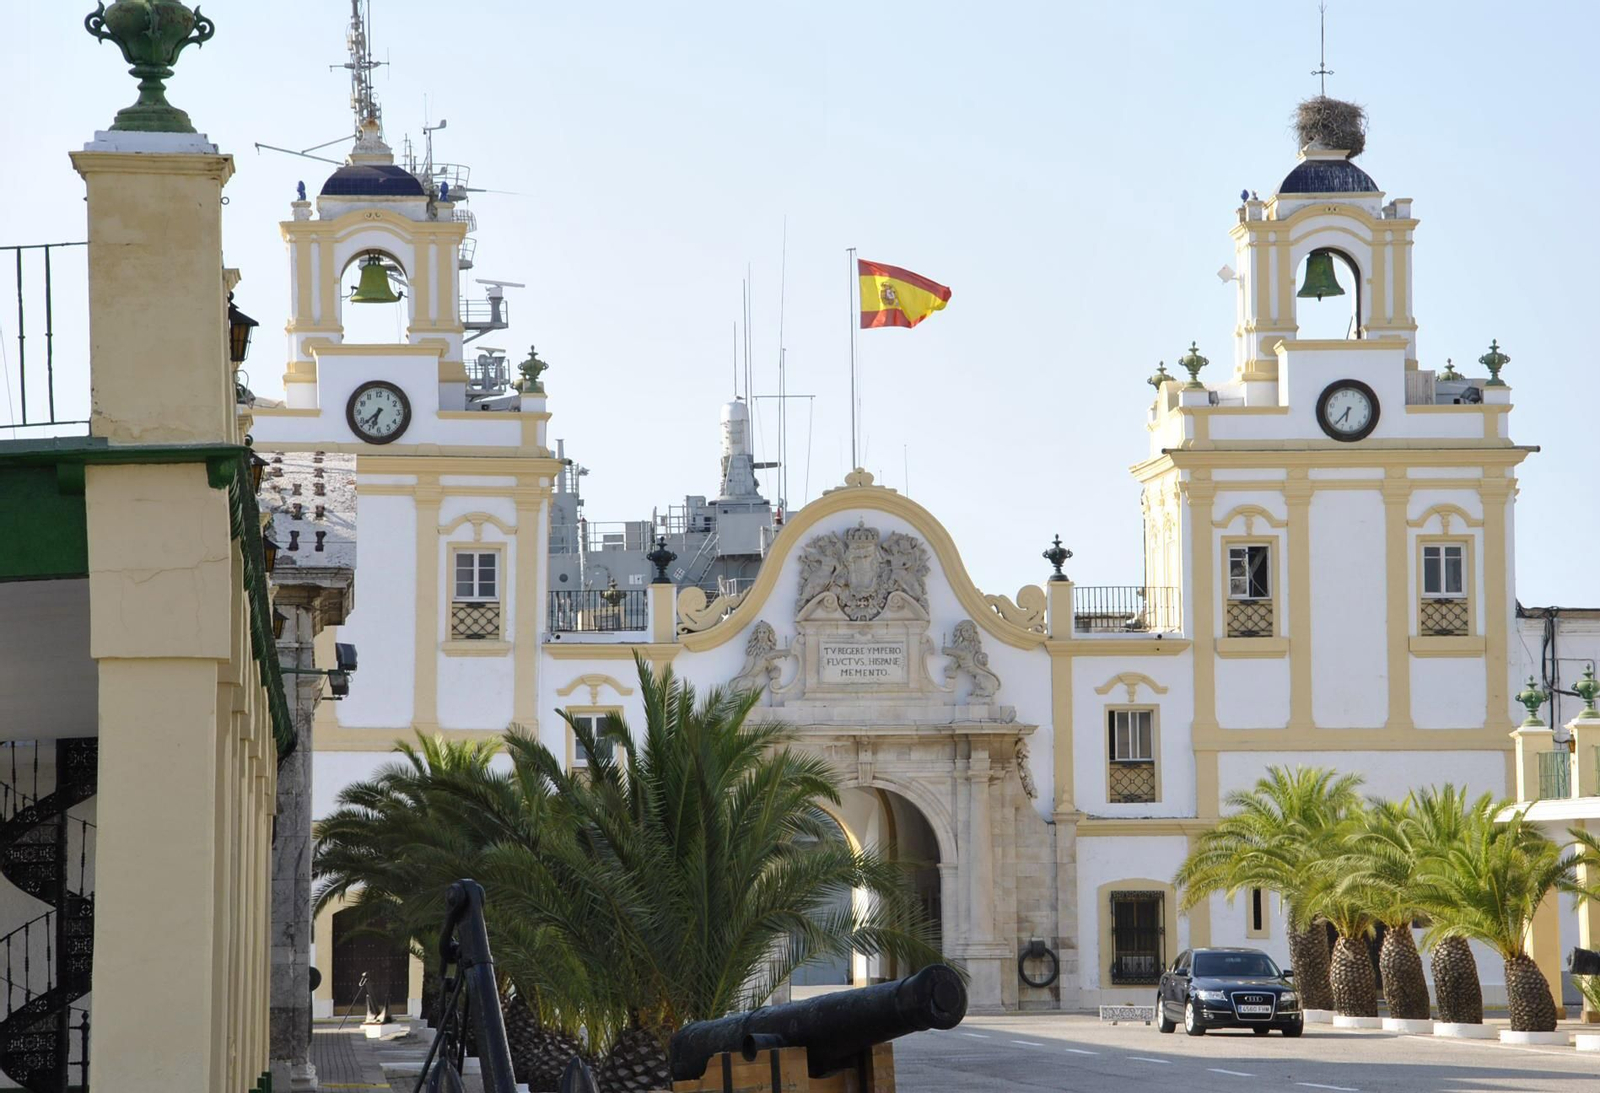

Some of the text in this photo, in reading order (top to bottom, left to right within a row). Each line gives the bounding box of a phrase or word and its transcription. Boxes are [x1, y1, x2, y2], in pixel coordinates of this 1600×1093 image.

[823, 647, 902, 655] TV REGERE YMPERIO
[868, 657, 901, 666] HISPANE
